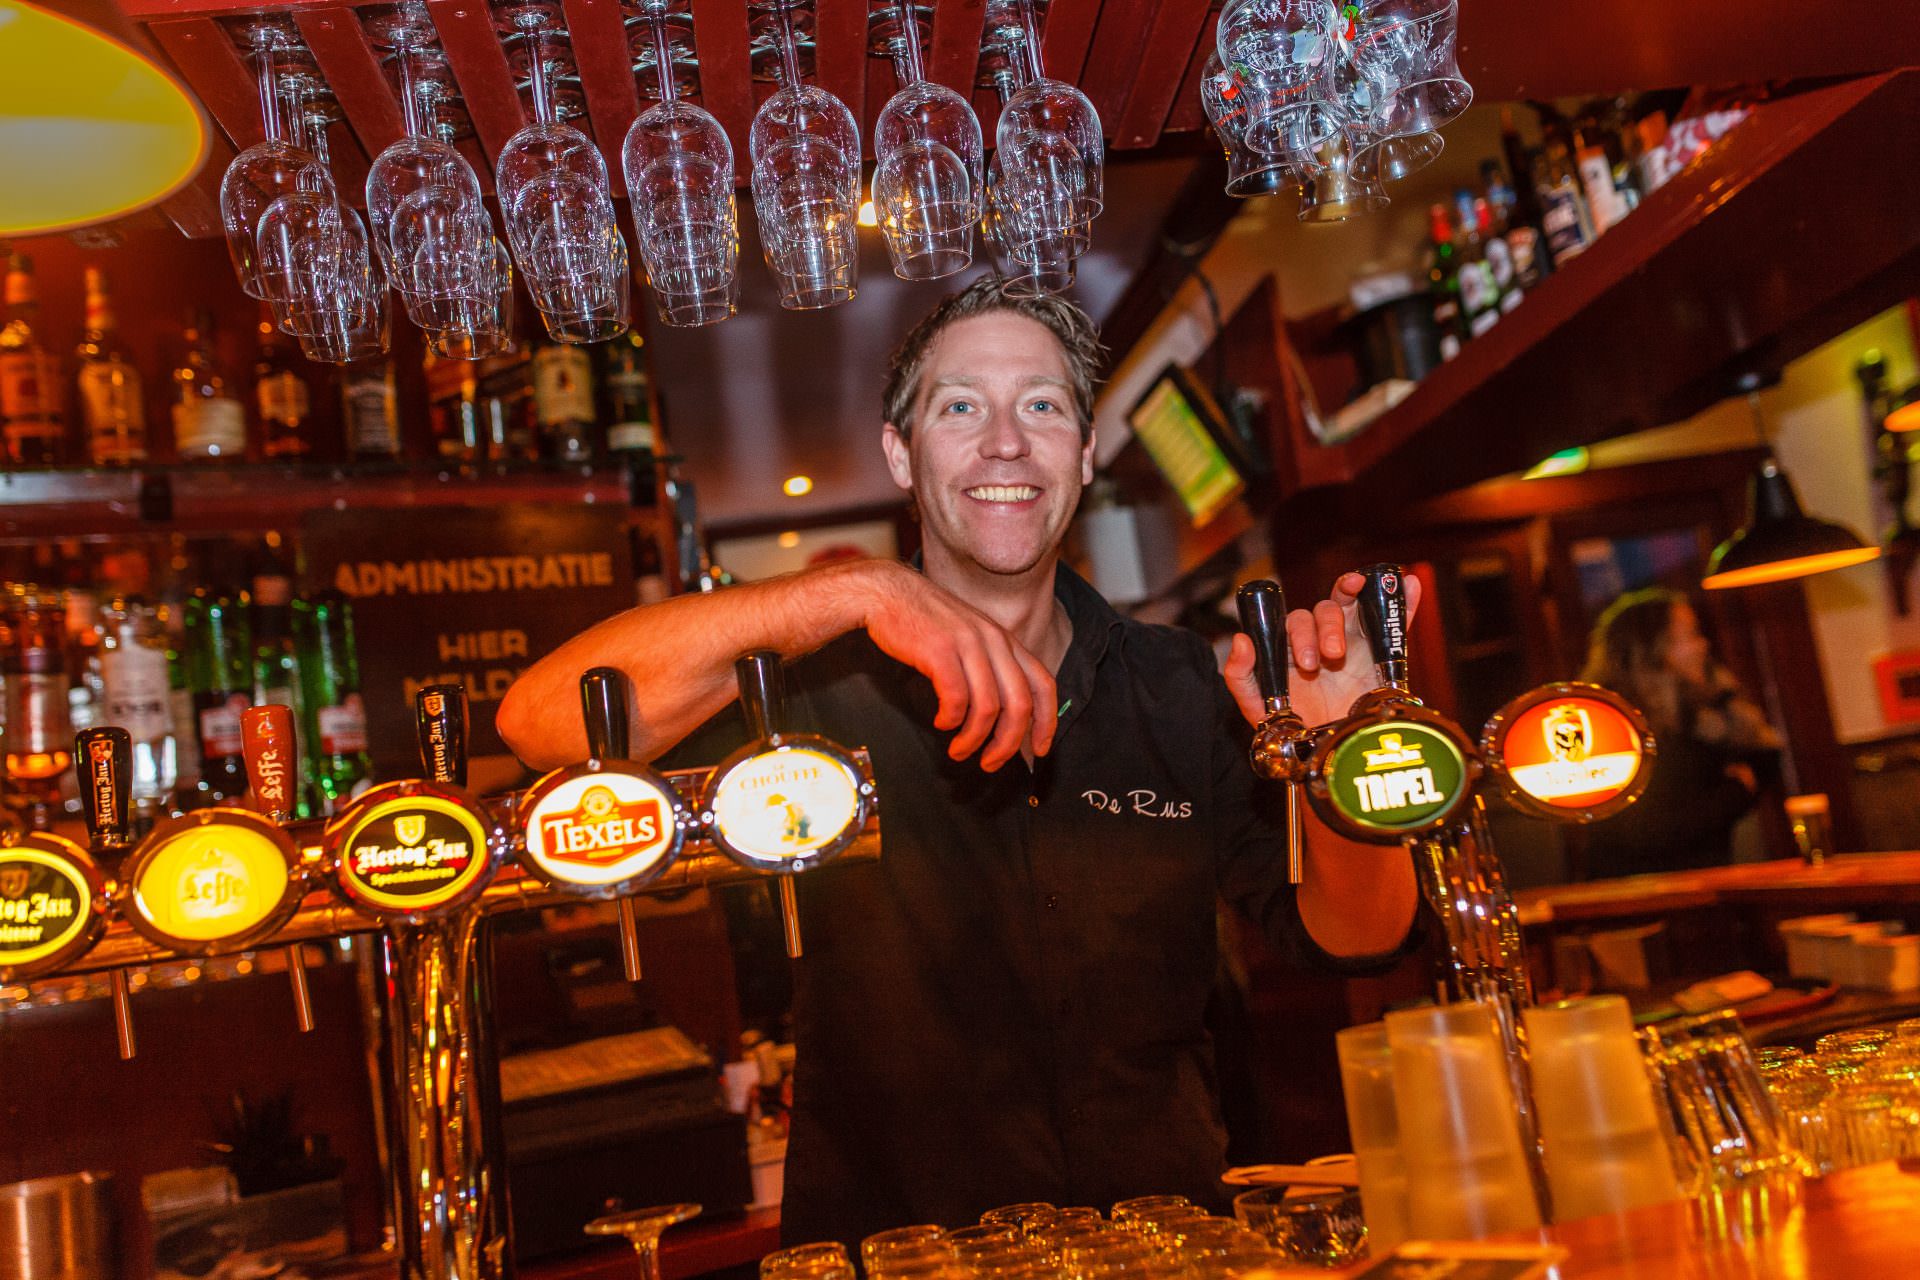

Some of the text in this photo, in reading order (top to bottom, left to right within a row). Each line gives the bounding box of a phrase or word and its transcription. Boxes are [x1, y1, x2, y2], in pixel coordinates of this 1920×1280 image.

[335, 552, 613, 598] ADMINISTRATIE
[437, 629, 528, 662] HIER
[1386, 598, 1404, 655] Jupiler
[429, 720, 452, 783] Hertog Jan
[257, 748, 285, 802] Leffe
[99, 786, 115, 825] Hertog
[1081, 789, 1193, 818] De Rus
[543, 815, 656, 855] TEXELS
[355, 838, 468, 875] Hertog Jan
[182, 871, 248, 906] Leffe
[28, 893, 73, 924] Jan
